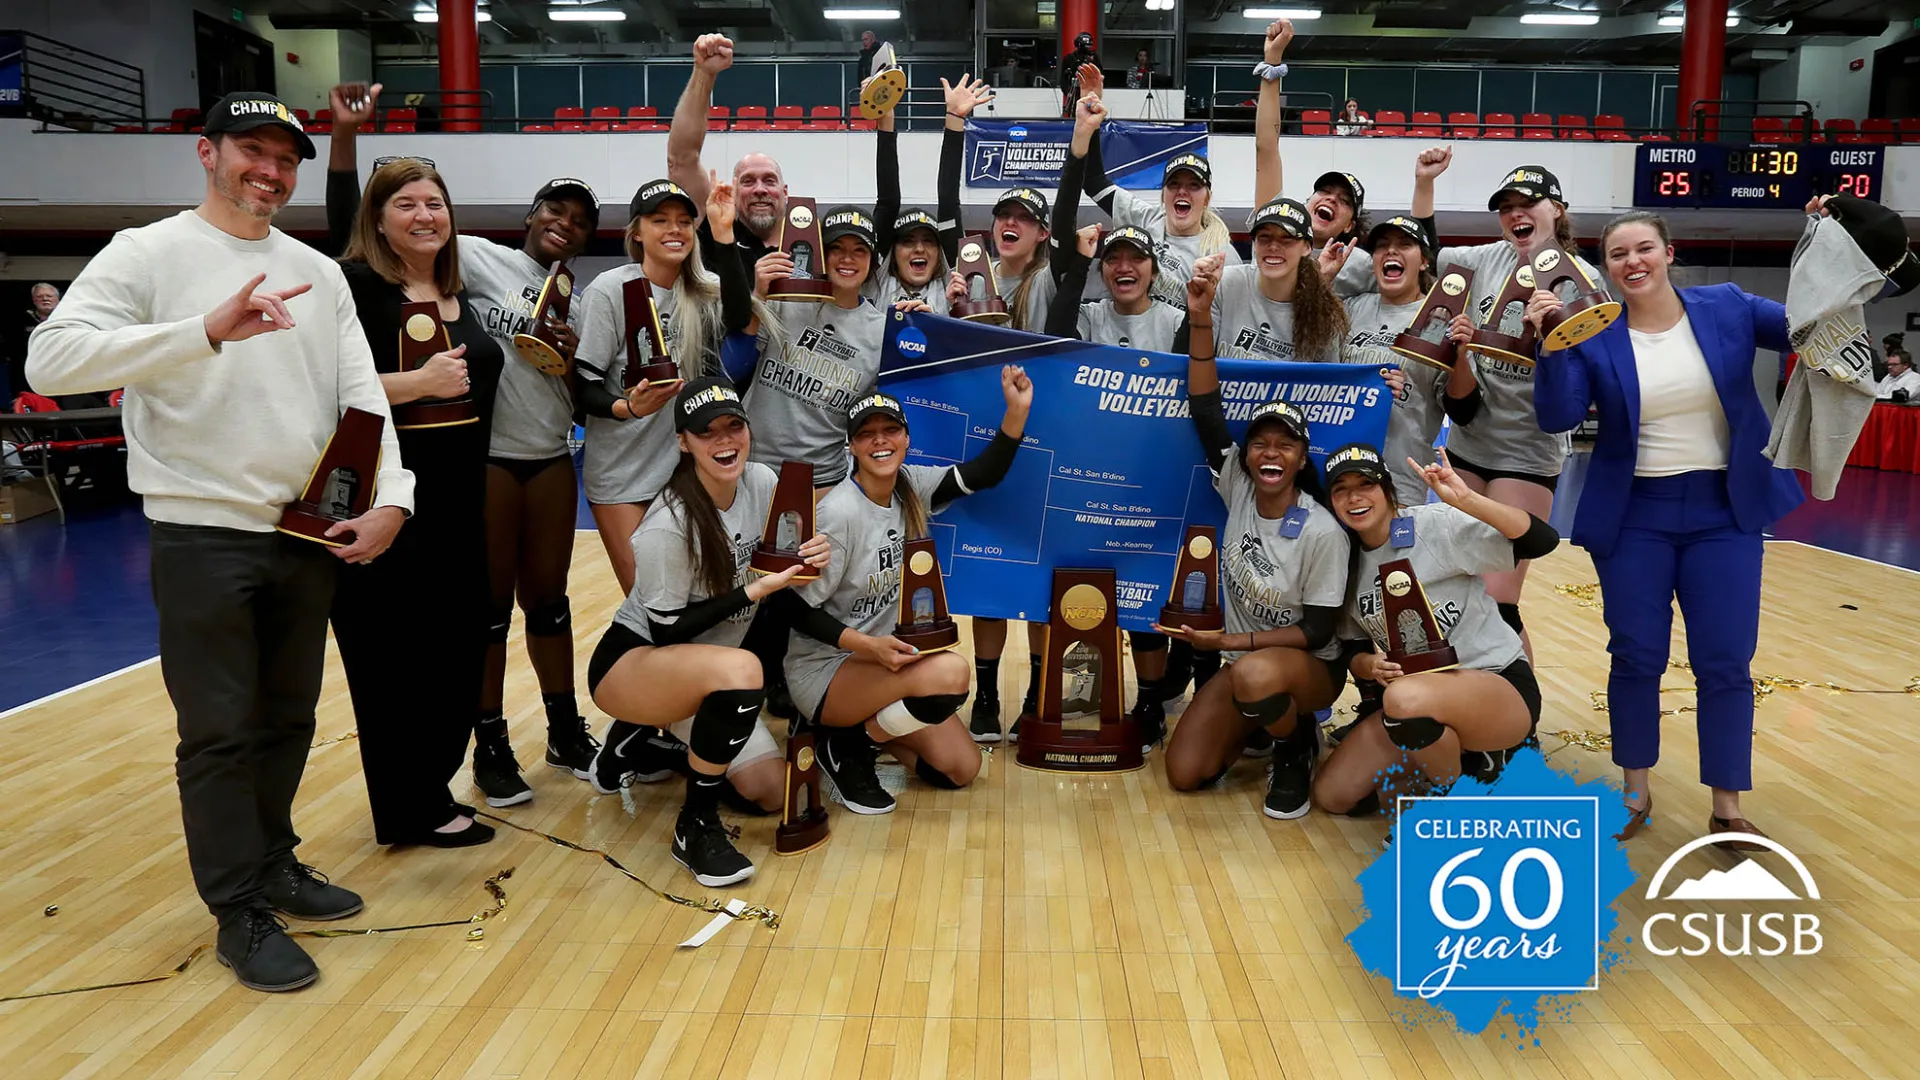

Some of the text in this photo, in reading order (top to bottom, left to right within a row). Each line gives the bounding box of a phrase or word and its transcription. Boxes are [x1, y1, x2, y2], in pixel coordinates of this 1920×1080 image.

[1006, 148, 1067, 161] VOLLEYBAL
[1649, 149, 1696, 163] METRO
[1830, 151, 1876, 165] GUEST
[1004, 161, 1064, 171] CHAMPIONSHIP
[1751, 151, 1798, 175] 1:30
[1659, 172, 1690, 195] 25
[1731, 184, 1780, 198] PERIOD 4
[1839, 174, 1870, 198] 20
[792, 216, 812, 224] NCAA
[825, 211, 874, 233] CHAMPIONS
[1256, 203, 1305, 225] CHAMPIONS
[1538, 253, 1560, 270] NCAA
[899, 340, 926, 353] NCAA
[779, 340, 864, 393] NATIONAL
[762, 358, 856, 411] CHAMPION
[1073, 365, 1125, 391] 2019
[1271, 383, 1289, 401] II
[1289, 383, 1380, 407] WOMEN'S
[683, 384, 740, 415] CHAMPIONS
[849, 394, 901, 420] CHAMPIONS
[1098, 391, 1193, 419] VOLLEYBA
[1251, 402, 1303, 424] CHAMPIONS
[973, 425, 987, 434] Cal
[1022, 436, 1040, 445] dino
[1326, 447, 1378, 473] CHAMPIONS
[1058, 465, 1126, 481] Cal St. San B'dino
[1086, 500, 1099, 509] Cal
[1112, 504, 1127, 512] San
[1128, 505, 1152, 514] B'dino
[1075, 514, 1157, 528] NATIONAL CHAMPION
[962, 543, 1003, 556] Regis (CO)
[1105, 540, 1154, 550] Neb.-Kearney
[1116, 586, 1153, 602] EYBALL
[1388, 581, 1412, 592] NCAA
[1064, 605, 1106, 620] NCAA
[1045, 752, 1118, 763] NATIONAL CHAMPION
